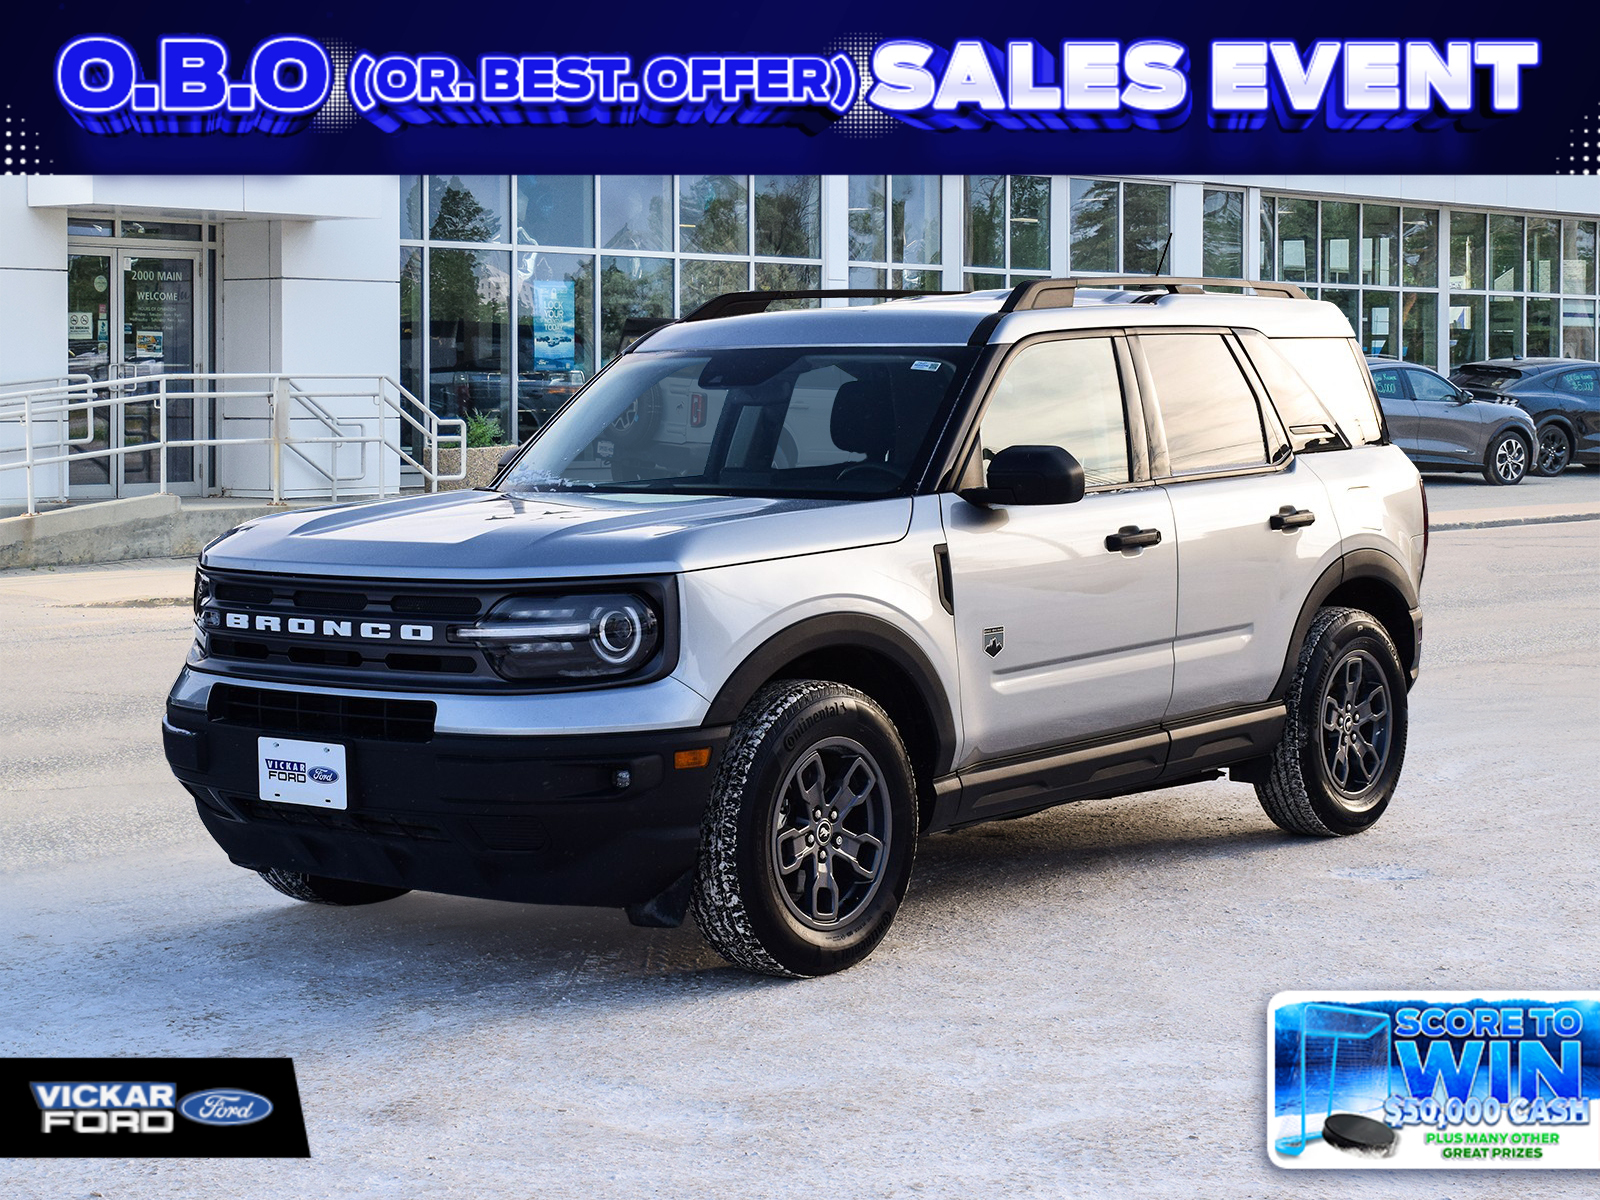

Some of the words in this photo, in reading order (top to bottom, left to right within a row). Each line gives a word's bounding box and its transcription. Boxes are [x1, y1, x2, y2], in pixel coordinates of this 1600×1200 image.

[132, 271, 155, 281] 2000
[157, 271, 182, 282] MAIN
[137, 291, 178, 301] WELCOME
[544, 310, 564, 318] YOUR
[226, 612, 434, 641] BRONCO
[784, 702, 840, 752] Continental
[267, 760, 306, 772] VICKAR
[268, 771, 307, 783] FORD
[313, 768, 334, 782] Ford
